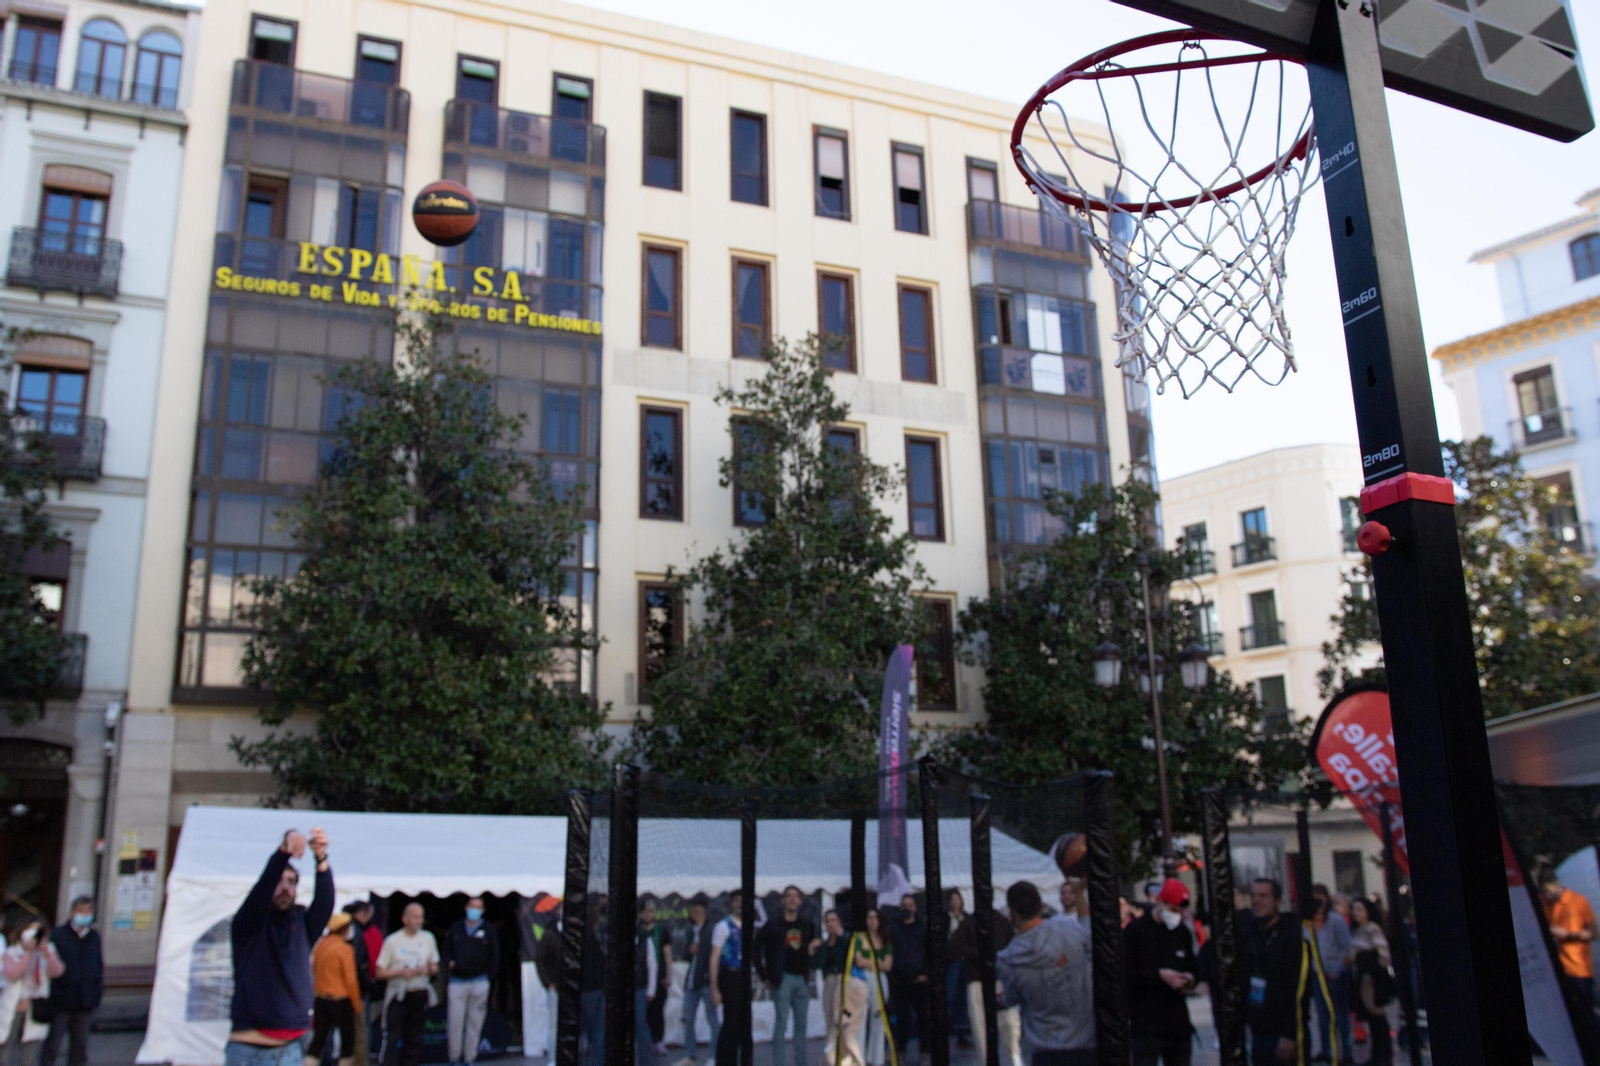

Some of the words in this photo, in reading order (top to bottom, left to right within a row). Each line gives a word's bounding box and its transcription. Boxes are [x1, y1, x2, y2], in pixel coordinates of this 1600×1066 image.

[1321, 141, 1355, 171] 2m40
[1342, 286, 1377, 313] 2m60
[1362, 443, 1400, 468] 2m80
